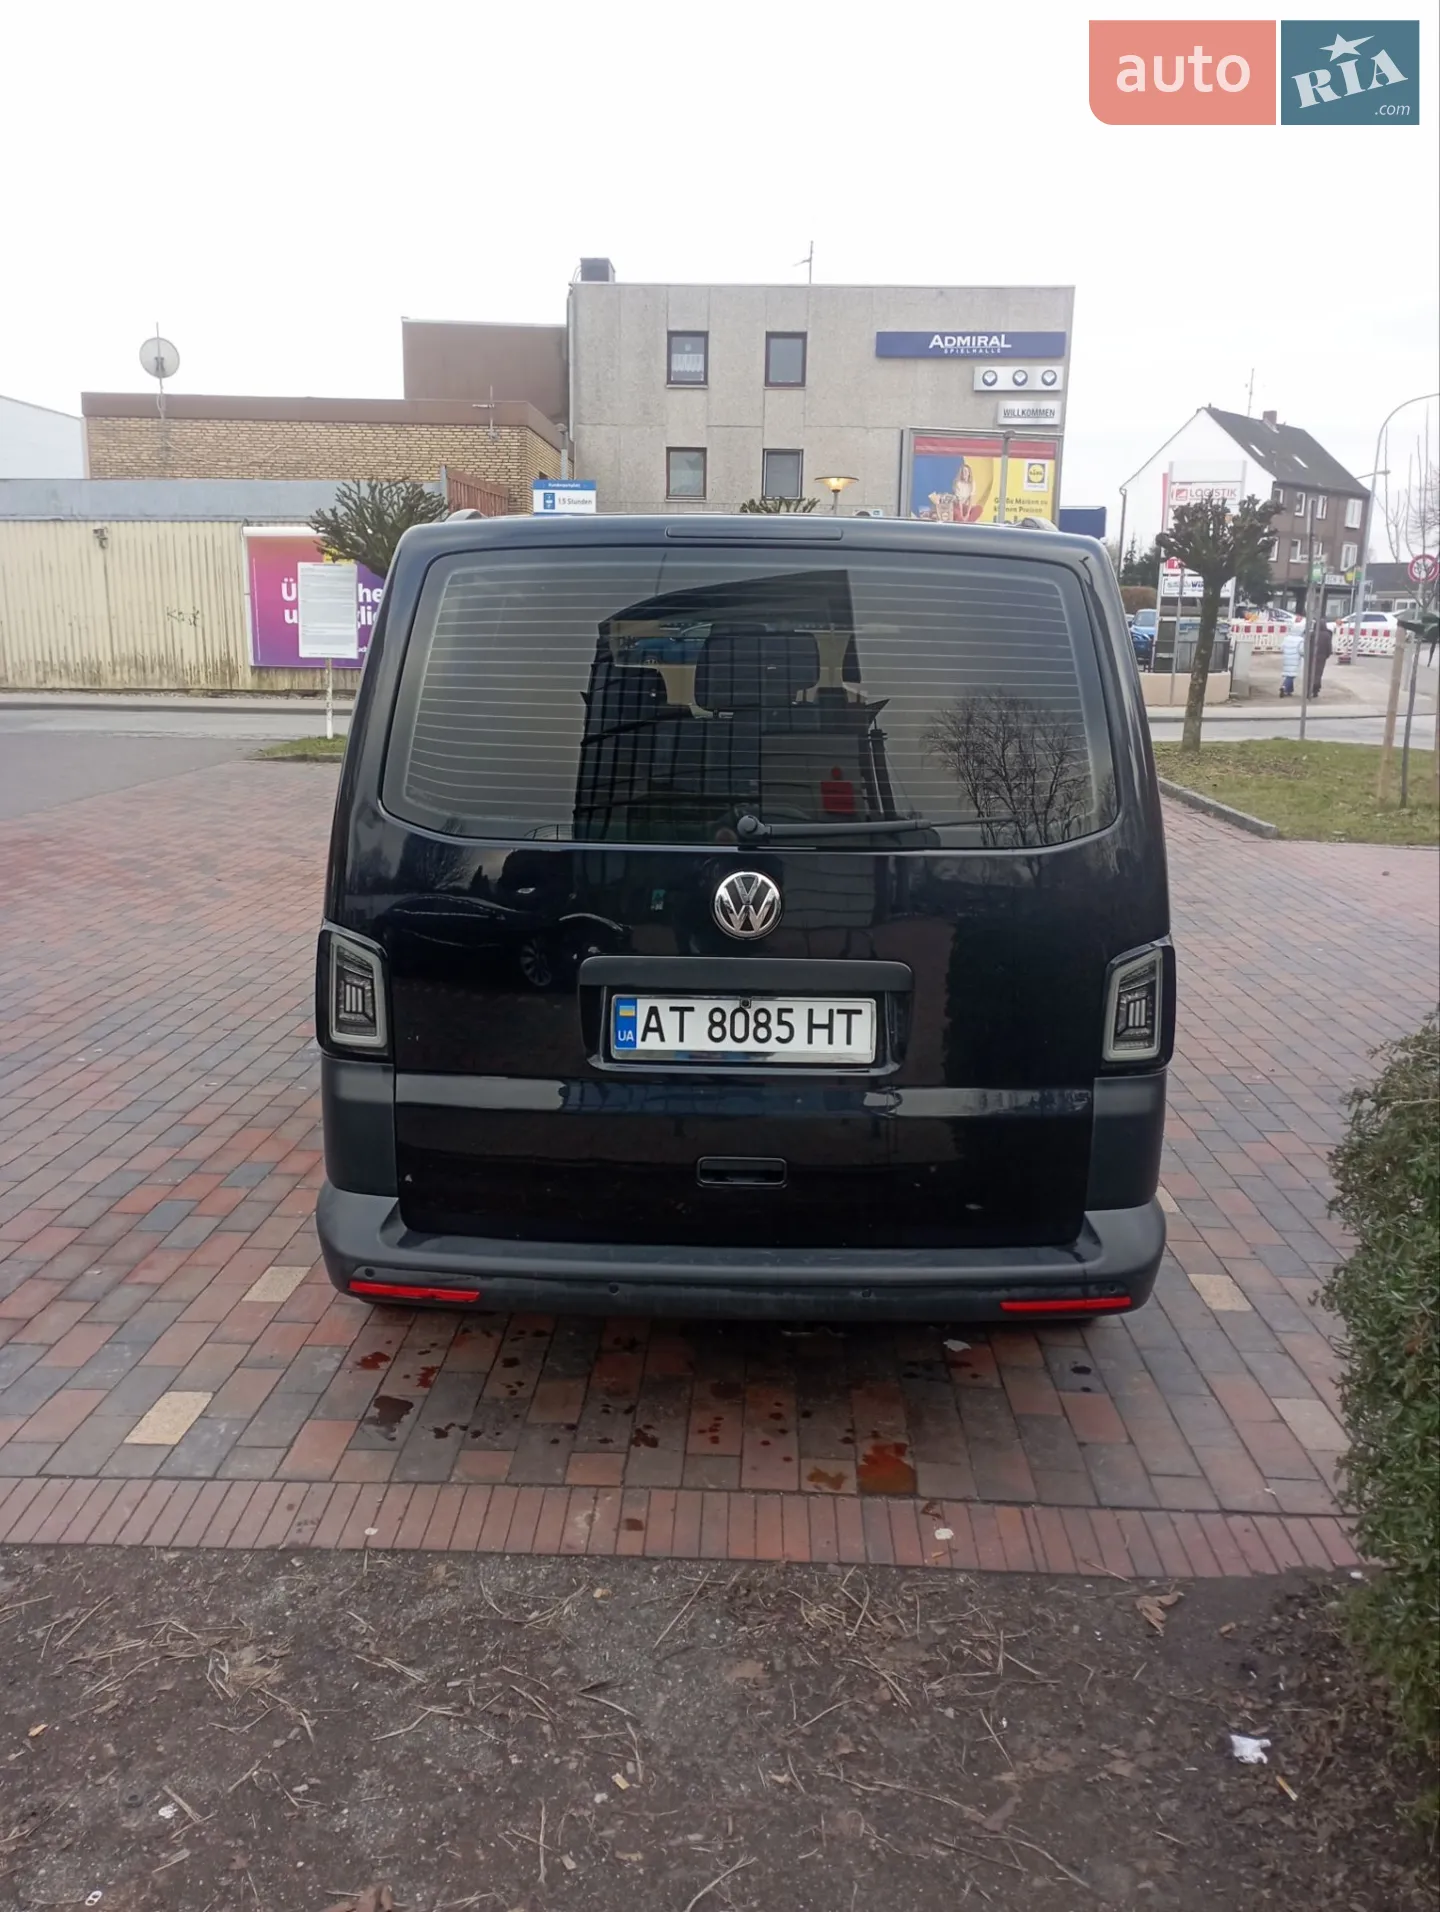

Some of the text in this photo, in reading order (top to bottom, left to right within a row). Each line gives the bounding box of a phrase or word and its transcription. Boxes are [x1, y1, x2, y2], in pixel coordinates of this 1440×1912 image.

[929, 334, 1012, 348] ADMIRAL
[1003, 408, 1056, 418] WILLKOMMEN
[1189, 488, 1237, 498] LOGISTIK
[567, 497, 593, 505] Stunden
[640, 1006, 863, 1046] AT 8085 HT
[617, 1030, 634, 1042] UA
